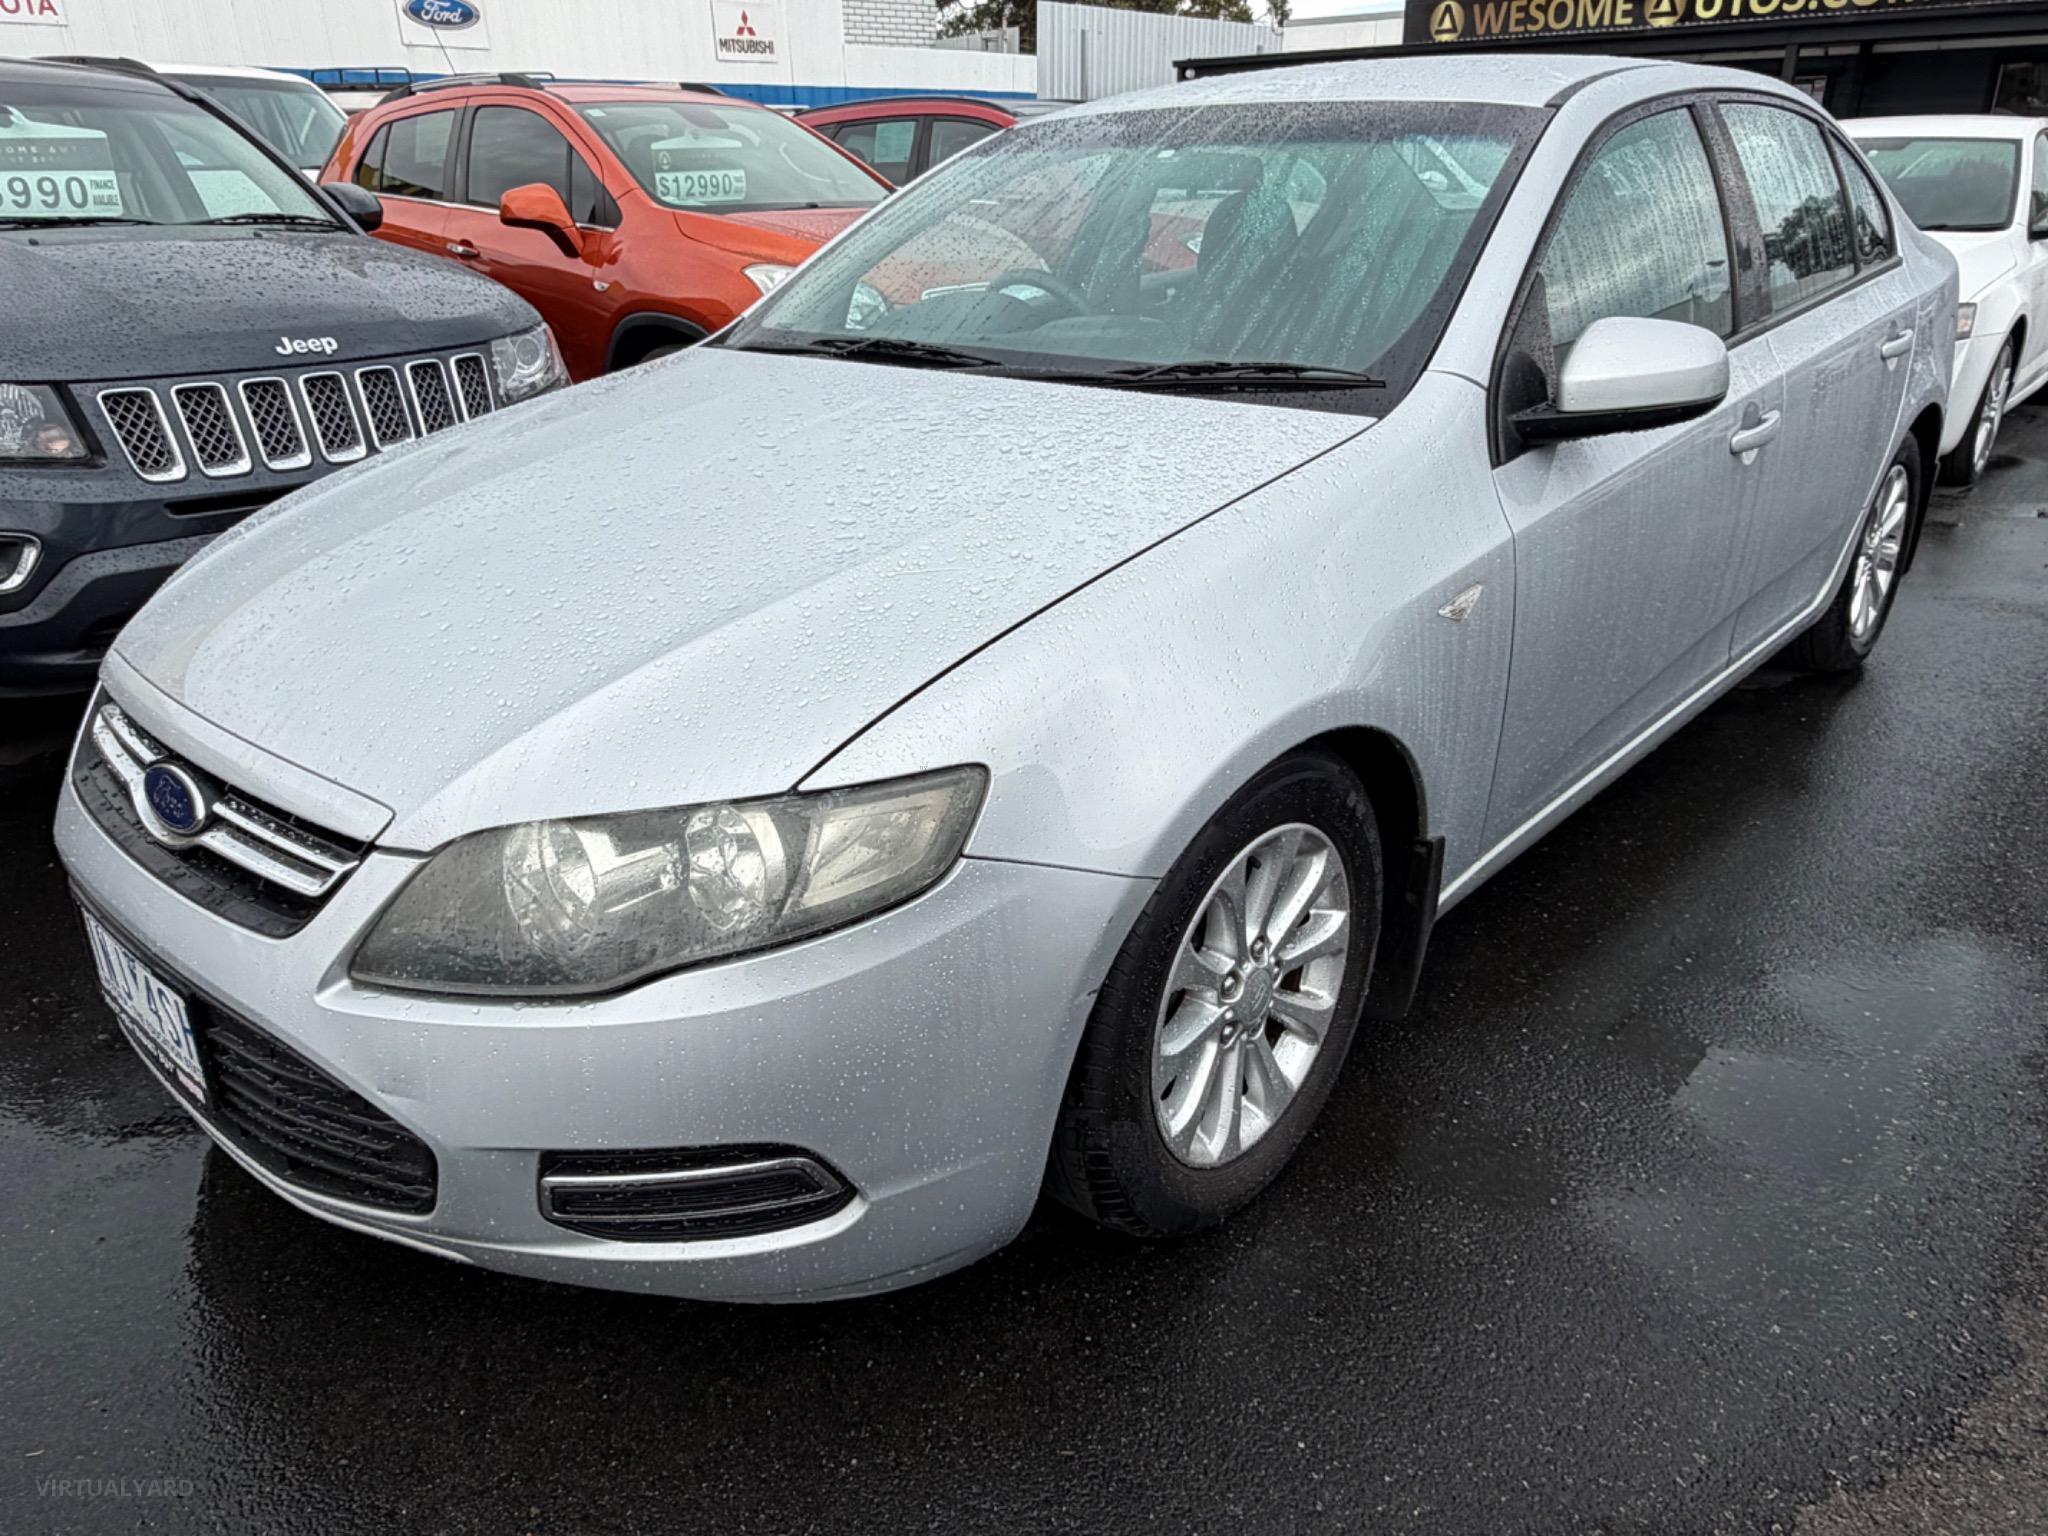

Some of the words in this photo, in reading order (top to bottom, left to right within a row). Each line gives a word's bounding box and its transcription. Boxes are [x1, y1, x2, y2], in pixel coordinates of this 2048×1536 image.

[421, 0, 464, 22] Ford
[719, 38, 775, 55] MITSUBISHI
[659, 173, 732, 201] $12990
[275, 336, 338, 355] Jeep
